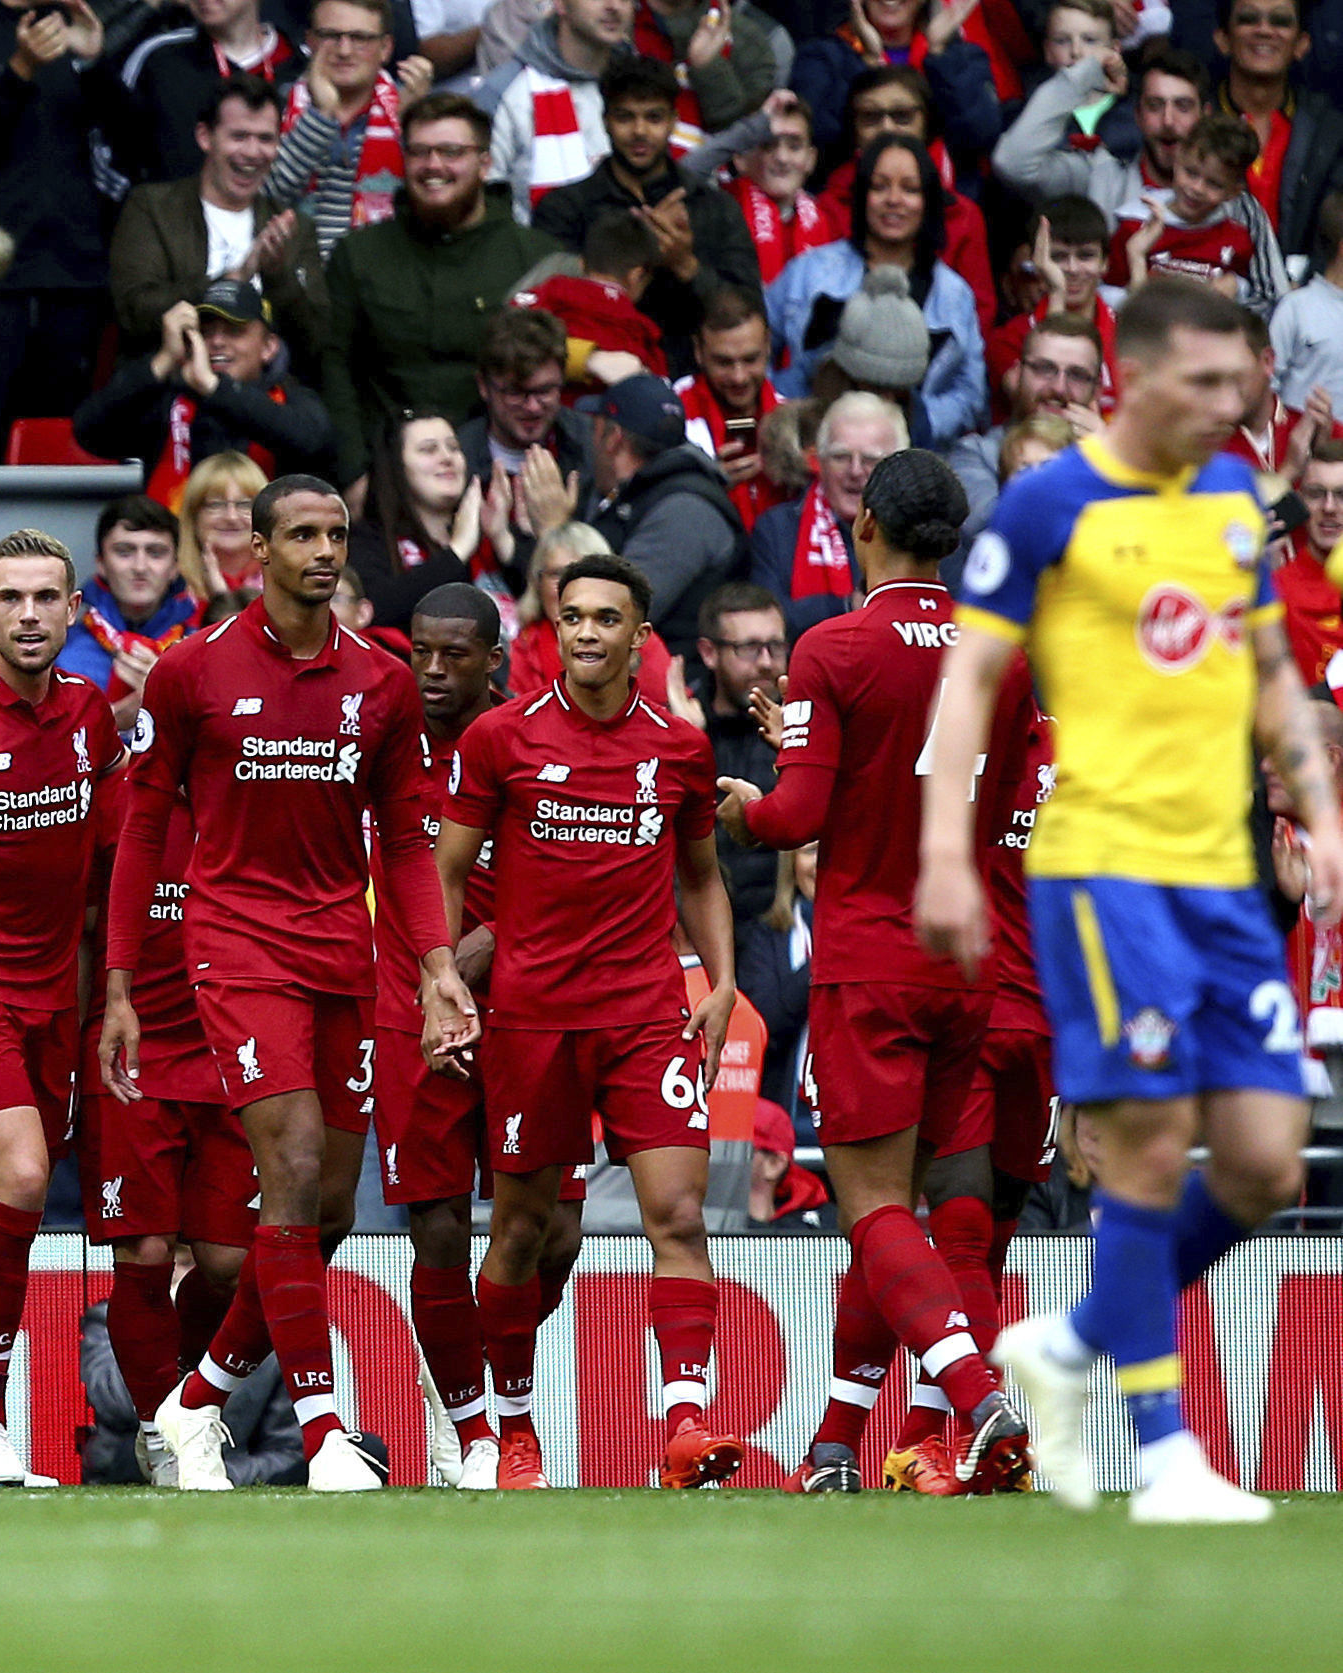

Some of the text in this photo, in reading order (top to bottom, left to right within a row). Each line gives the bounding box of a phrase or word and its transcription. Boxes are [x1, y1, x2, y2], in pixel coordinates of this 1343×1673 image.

[892, 621, 960, 648] VIRG
[242, 736, 336, 758] Standard
[235, 760, 334, 781] Chartered
[536, 799, 635, 824] Standard
[530, 821, 632, 845] Chartered
